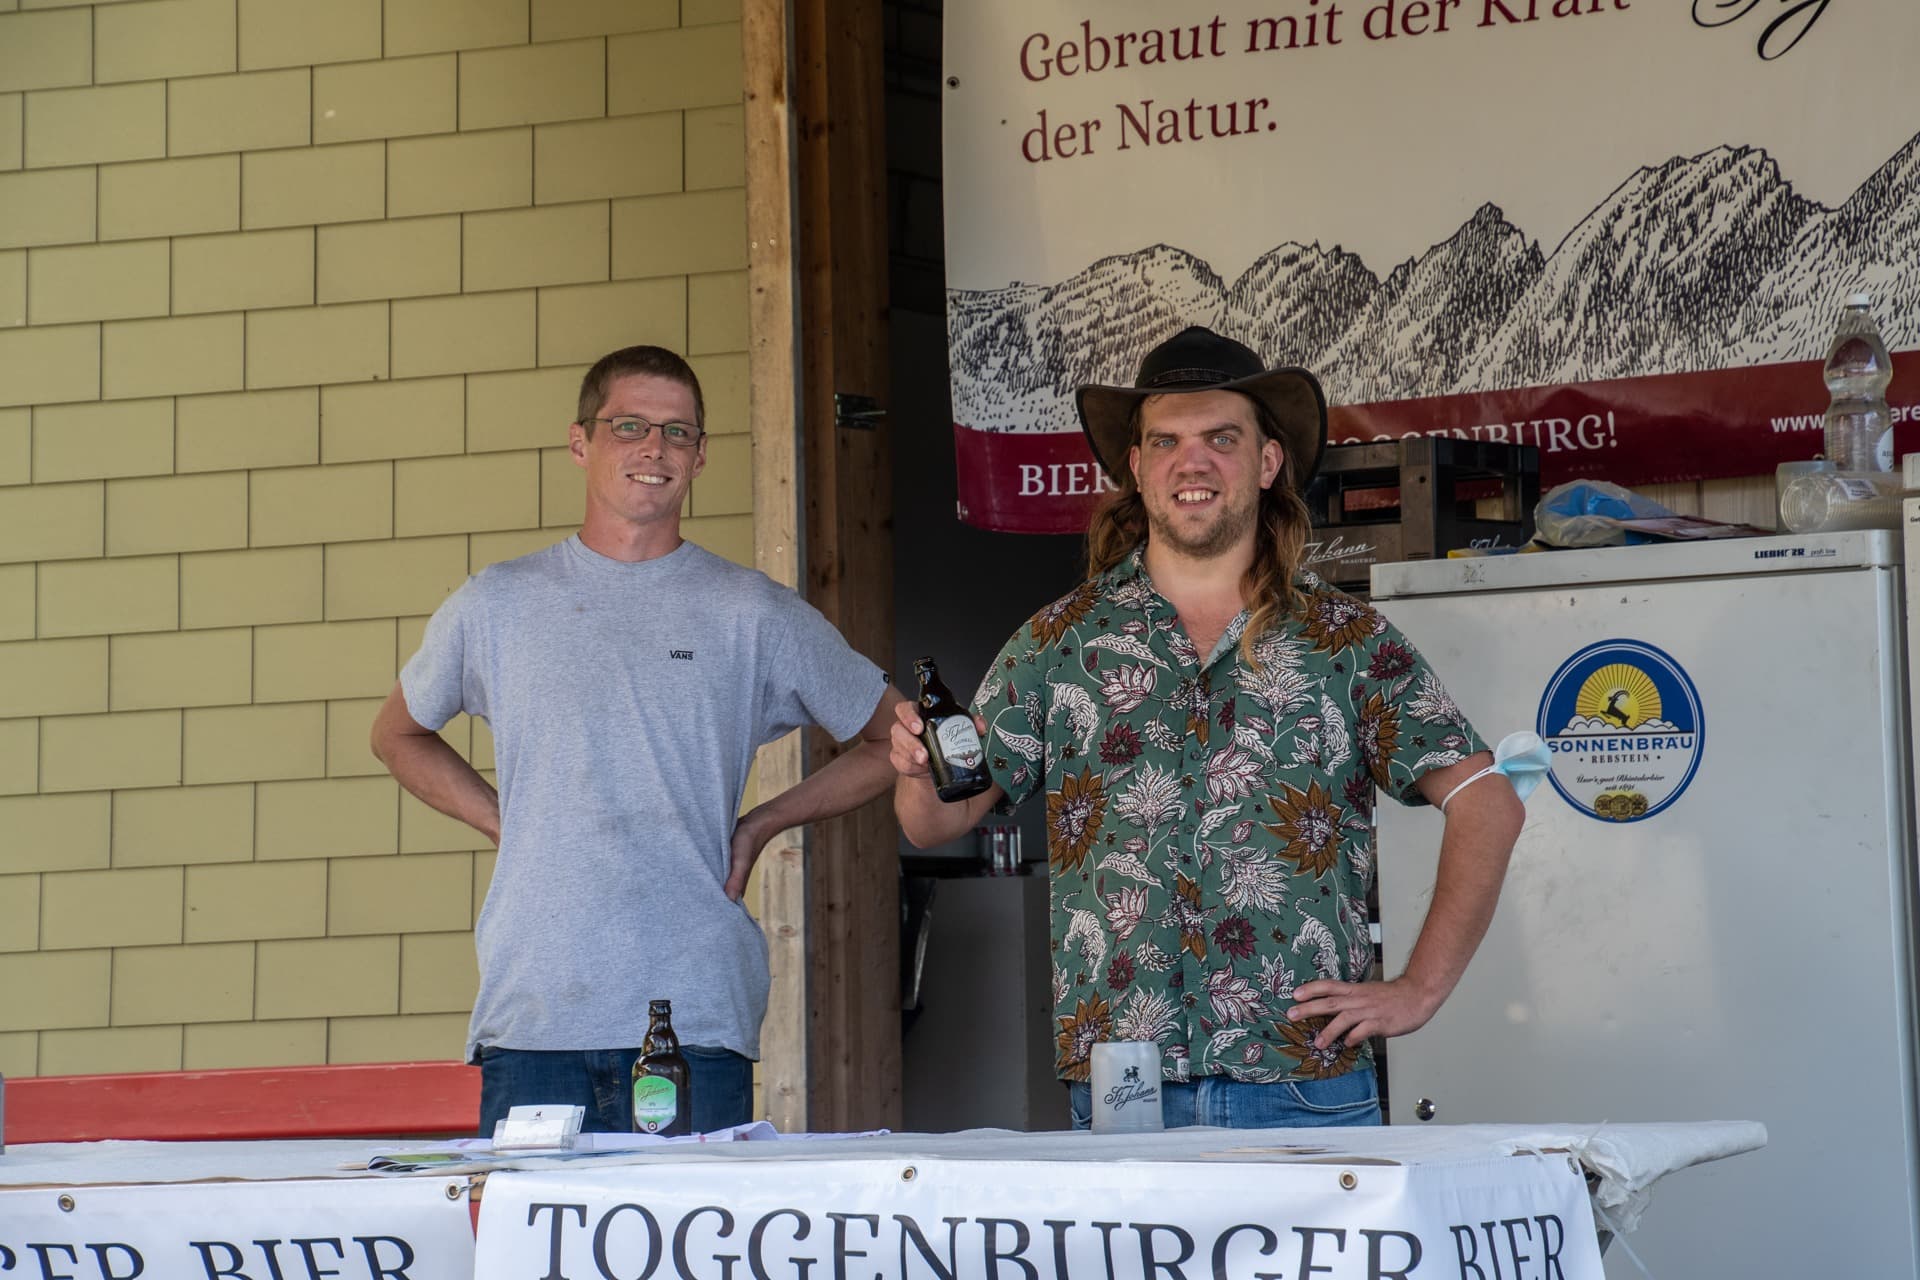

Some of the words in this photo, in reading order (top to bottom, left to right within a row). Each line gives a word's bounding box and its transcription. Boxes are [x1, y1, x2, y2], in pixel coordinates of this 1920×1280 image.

[1019, 14, 1227, 82] Gebraut
[1244, 0, 1343, 53] mit
[1362, 0, 1460, 40] der
[1477, 0, 1631, 27] Kra
[1020, 110, 1102, 163] der
[1116, 98, 1278, 151] Natur.
[669, 650, 693, 661] VANS
[1547, 736, 1693, 753] SONNENBRÄU
[1591, 754, 1649, 764] REBSTEIN
[528, 1202, 1424, 1280] TOGGENBURGER
[1449, 1214, 1566, 1280] BIER
